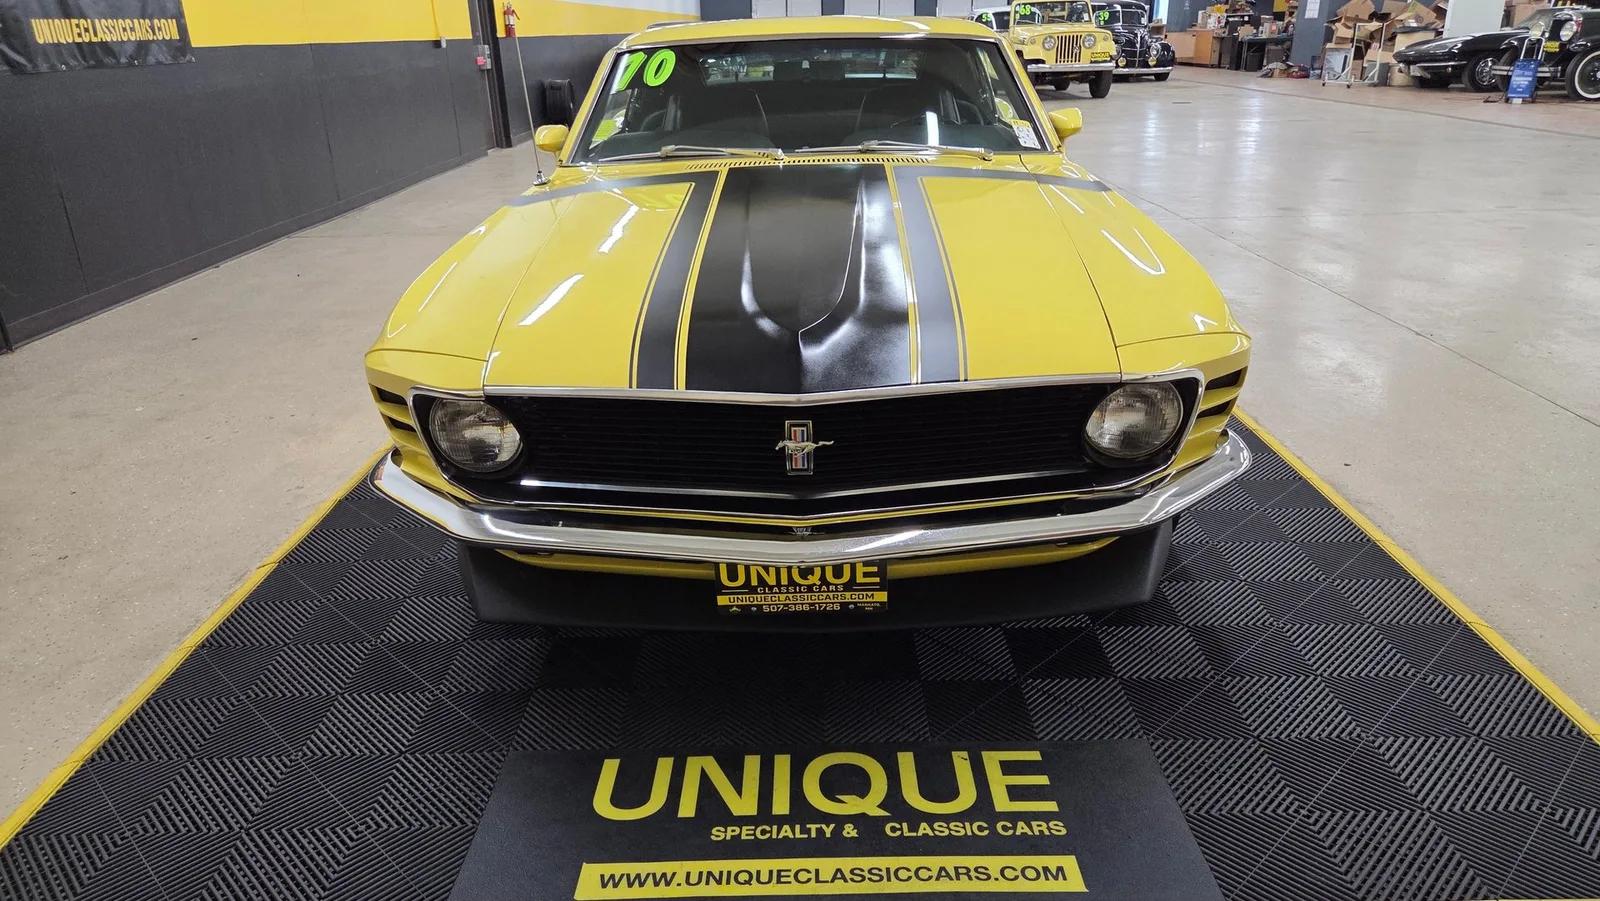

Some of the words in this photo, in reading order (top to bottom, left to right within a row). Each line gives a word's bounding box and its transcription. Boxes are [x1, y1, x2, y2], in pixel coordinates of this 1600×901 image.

[1019, 4, 1031, 15] 68
[31, 18, 180, 44] UNIQUECLASSICCARS.COM
[719, 561, 880, 587] UNIQUE
[728, 593, 875, 604] UNIQUECLASSICCARS.COM
[757, 586, 806, 594] CLASSIC
[813, 584, 844, 592] CARS
[762, 603, 841, 613] 507-386-1726
[592, 750, 1059, 821] UNIQUE
[710, 824, 835, 841] SPECIALTY
[842, 824, 858, 838] &
[884, 820, 990, 837] CLASSIC
[995, 819, 1067, 836] CARS
[600, 865, 1067, 889] WWW.UNIQUECLASSICCARS.COM
